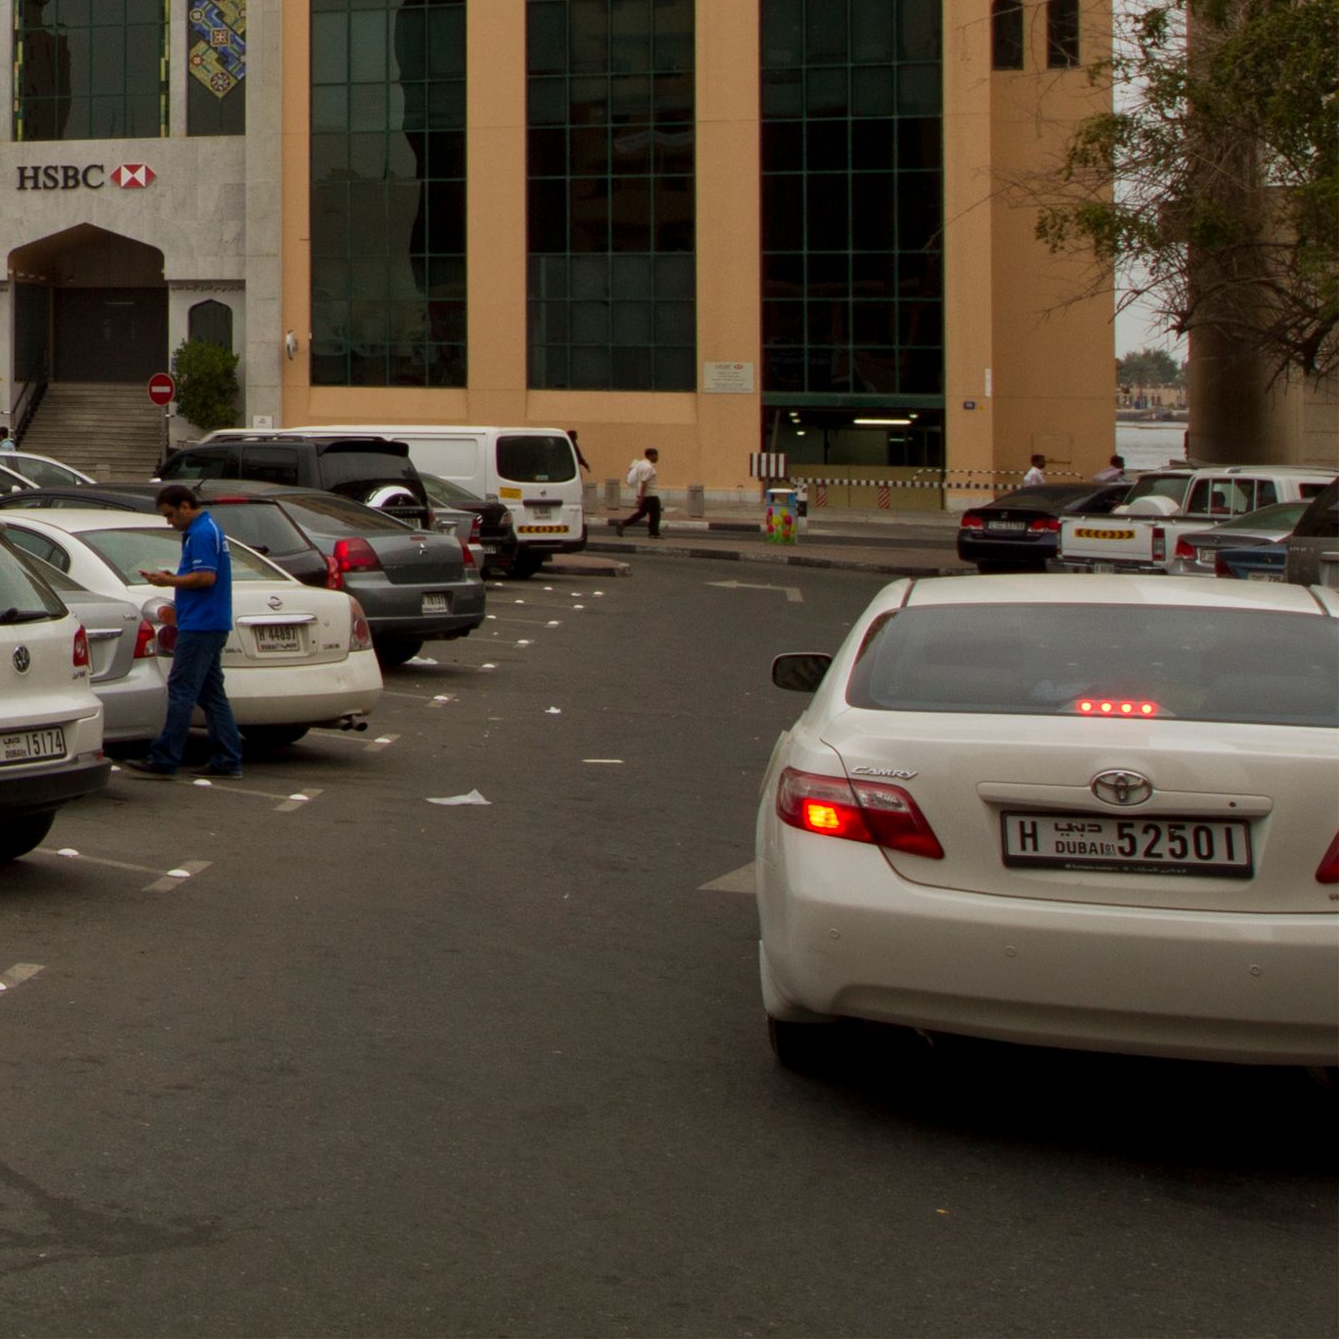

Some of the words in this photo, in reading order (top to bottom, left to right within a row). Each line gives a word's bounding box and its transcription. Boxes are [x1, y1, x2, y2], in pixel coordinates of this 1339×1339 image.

[17, 163, 105, 191] HSBC
[25, 730, 64, 757] 15174
[1019, 820, 1040, 852] H
[1054, 822, 1103, 837] دبي
[1116, 821, 1236, 861] 52501
[1054, 840, 1104, 855] DUBAI
